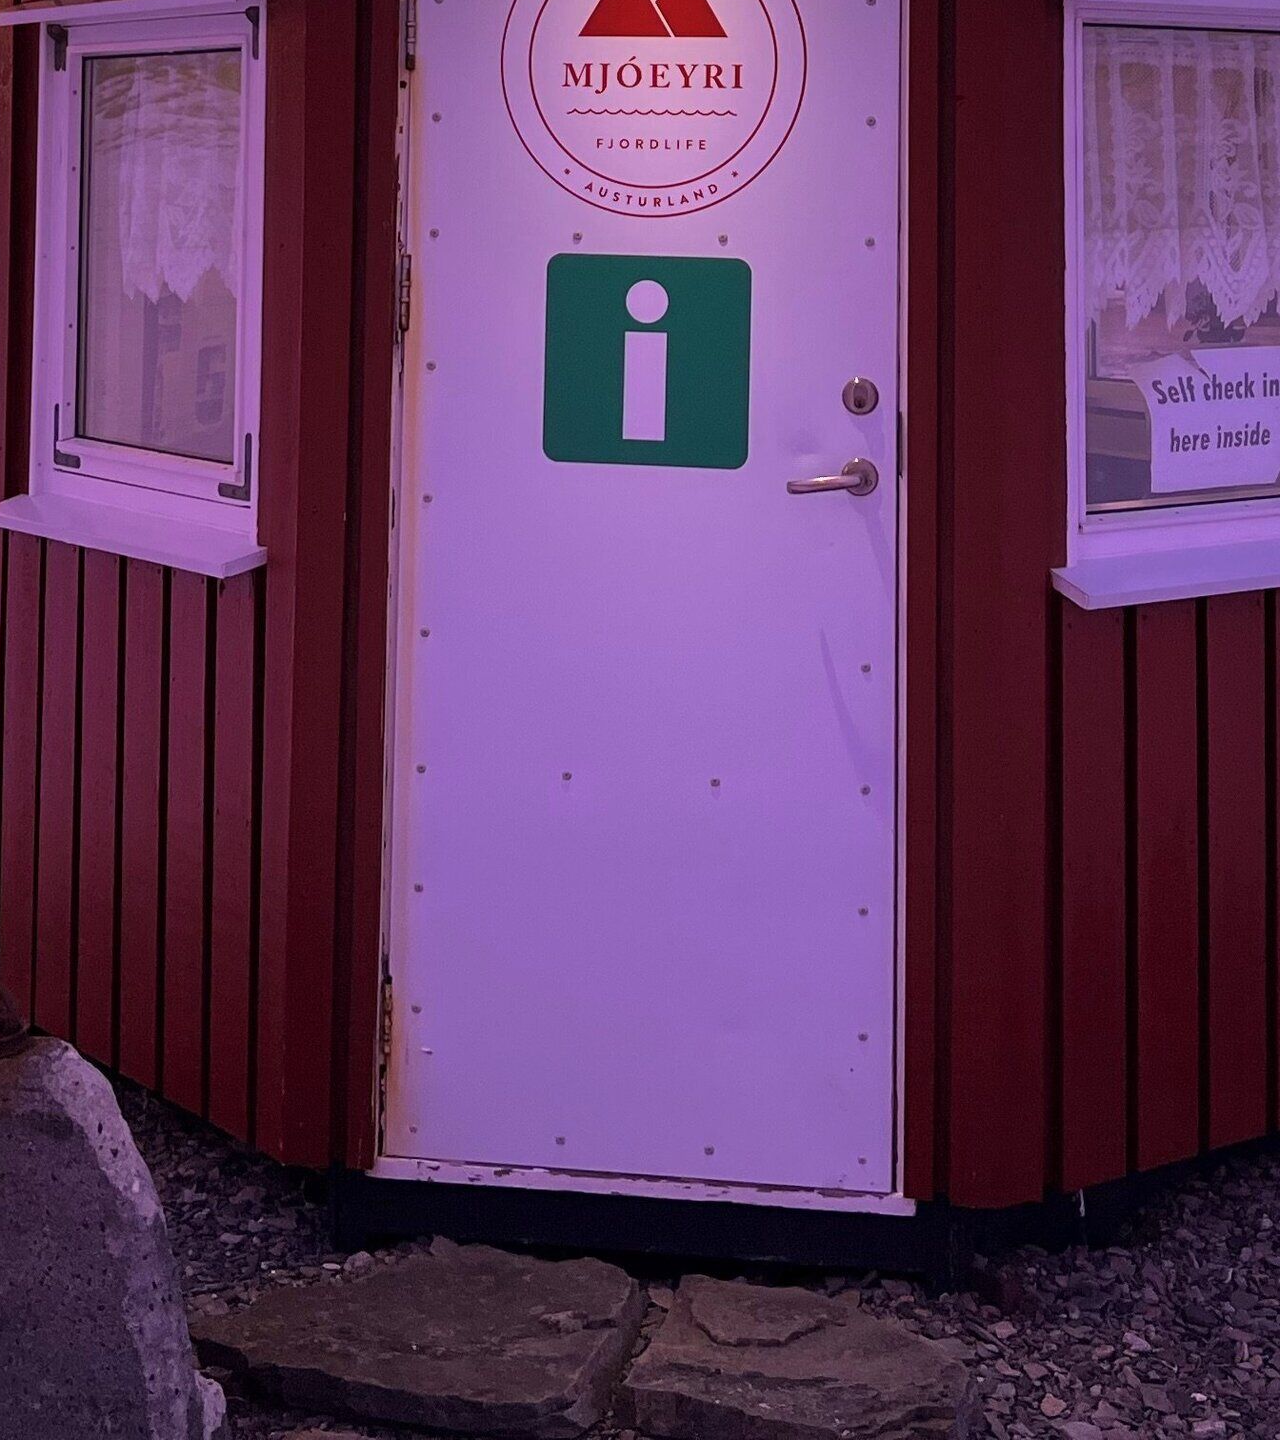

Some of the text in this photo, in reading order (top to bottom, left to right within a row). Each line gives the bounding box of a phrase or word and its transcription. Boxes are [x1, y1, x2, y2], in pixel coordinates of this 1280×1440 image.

[561, 55, 744, 95] MJÓEYRI
[596, 137, 708, 151] FJORDLIFE
[584, 181, 719, 208] AUSTURLAND
[1151, 372, 1280, 405] Self check in
[1169, 421, 1271, 453] here inside
